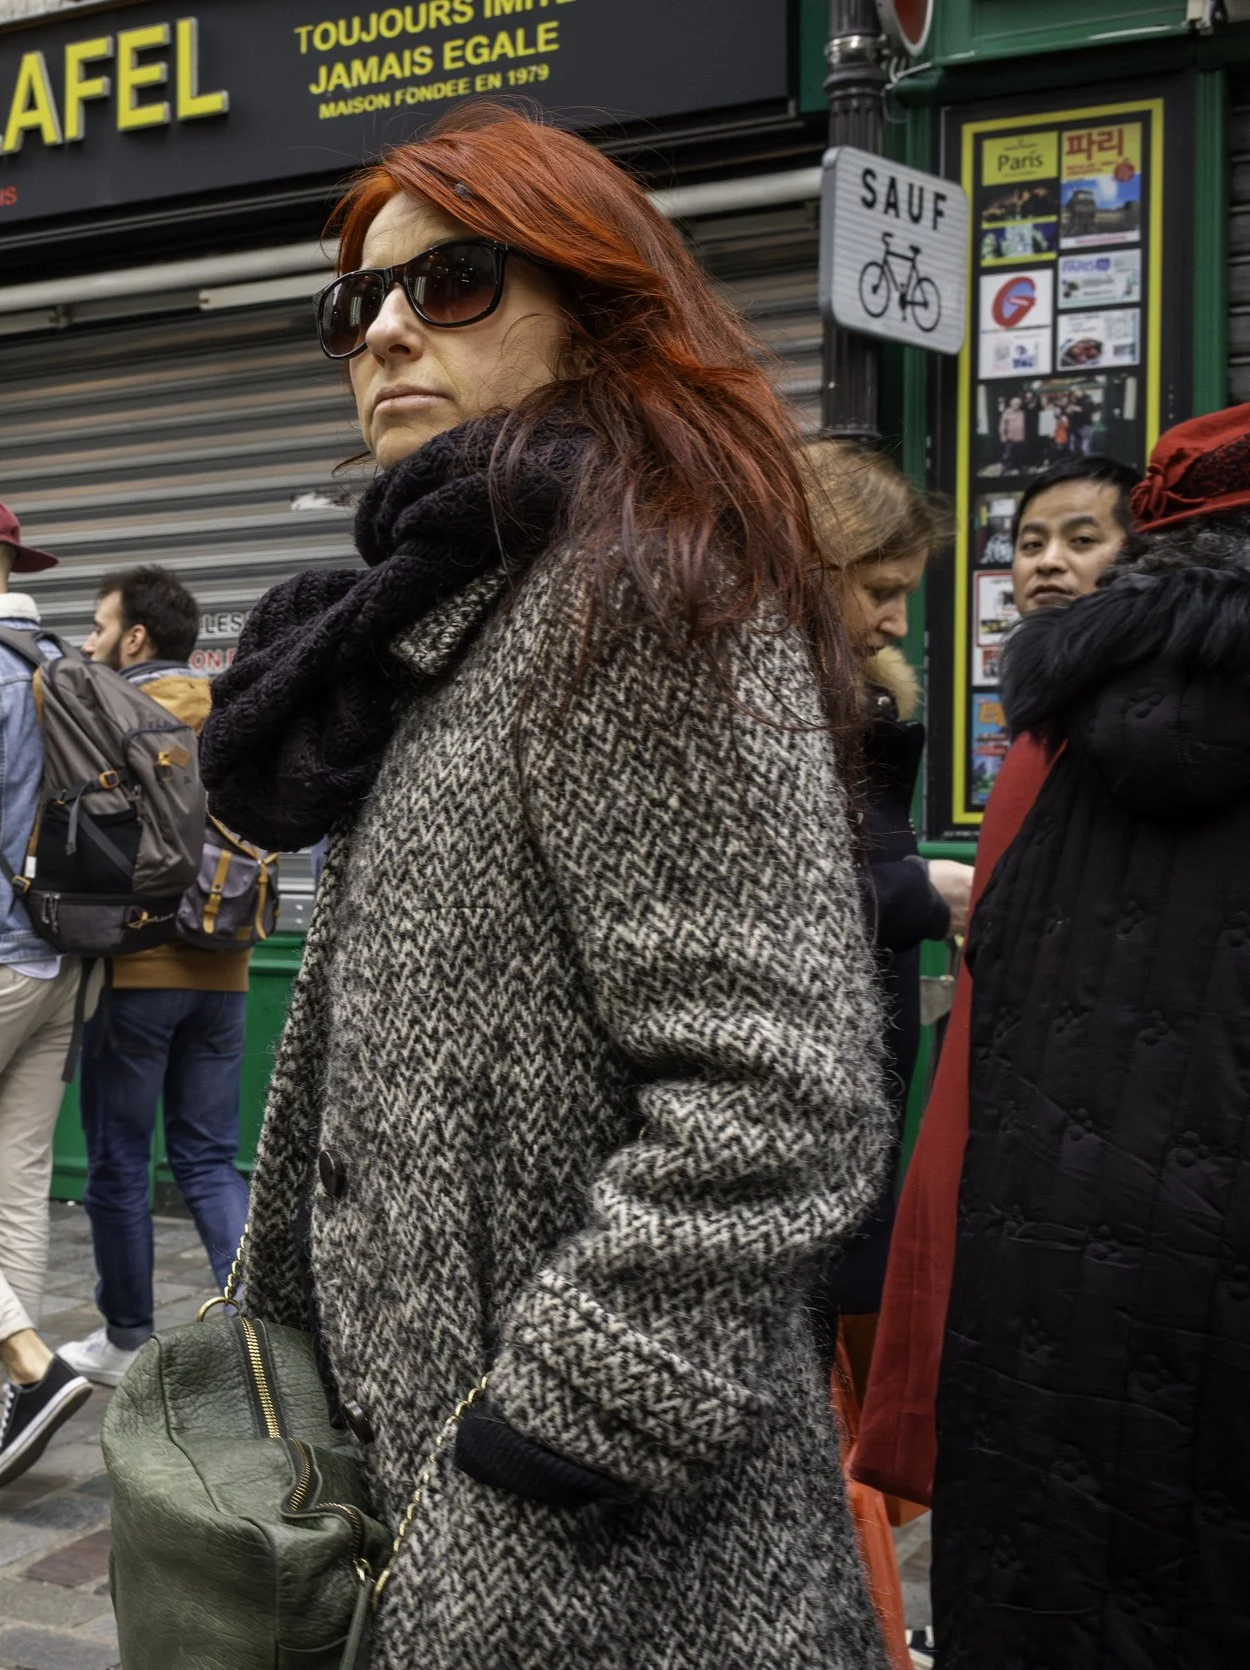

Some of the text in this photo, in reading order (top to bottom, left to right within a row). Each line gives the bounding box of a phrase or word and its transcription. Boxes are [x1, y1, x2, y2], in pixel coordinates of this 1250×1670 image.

[294, 0, 475, 54] TOUJOURS
[308, 21, 560, 95] JAMAIS EGALE
[318, 64, 550, 120] MAISON FONDEE EN 1979
[1065, 127, 1125, 161] 파리
[860, 168, 948, 231] SAUF
[205, 612, 245, 634] LES
[190, 651, 221, 670] ON
